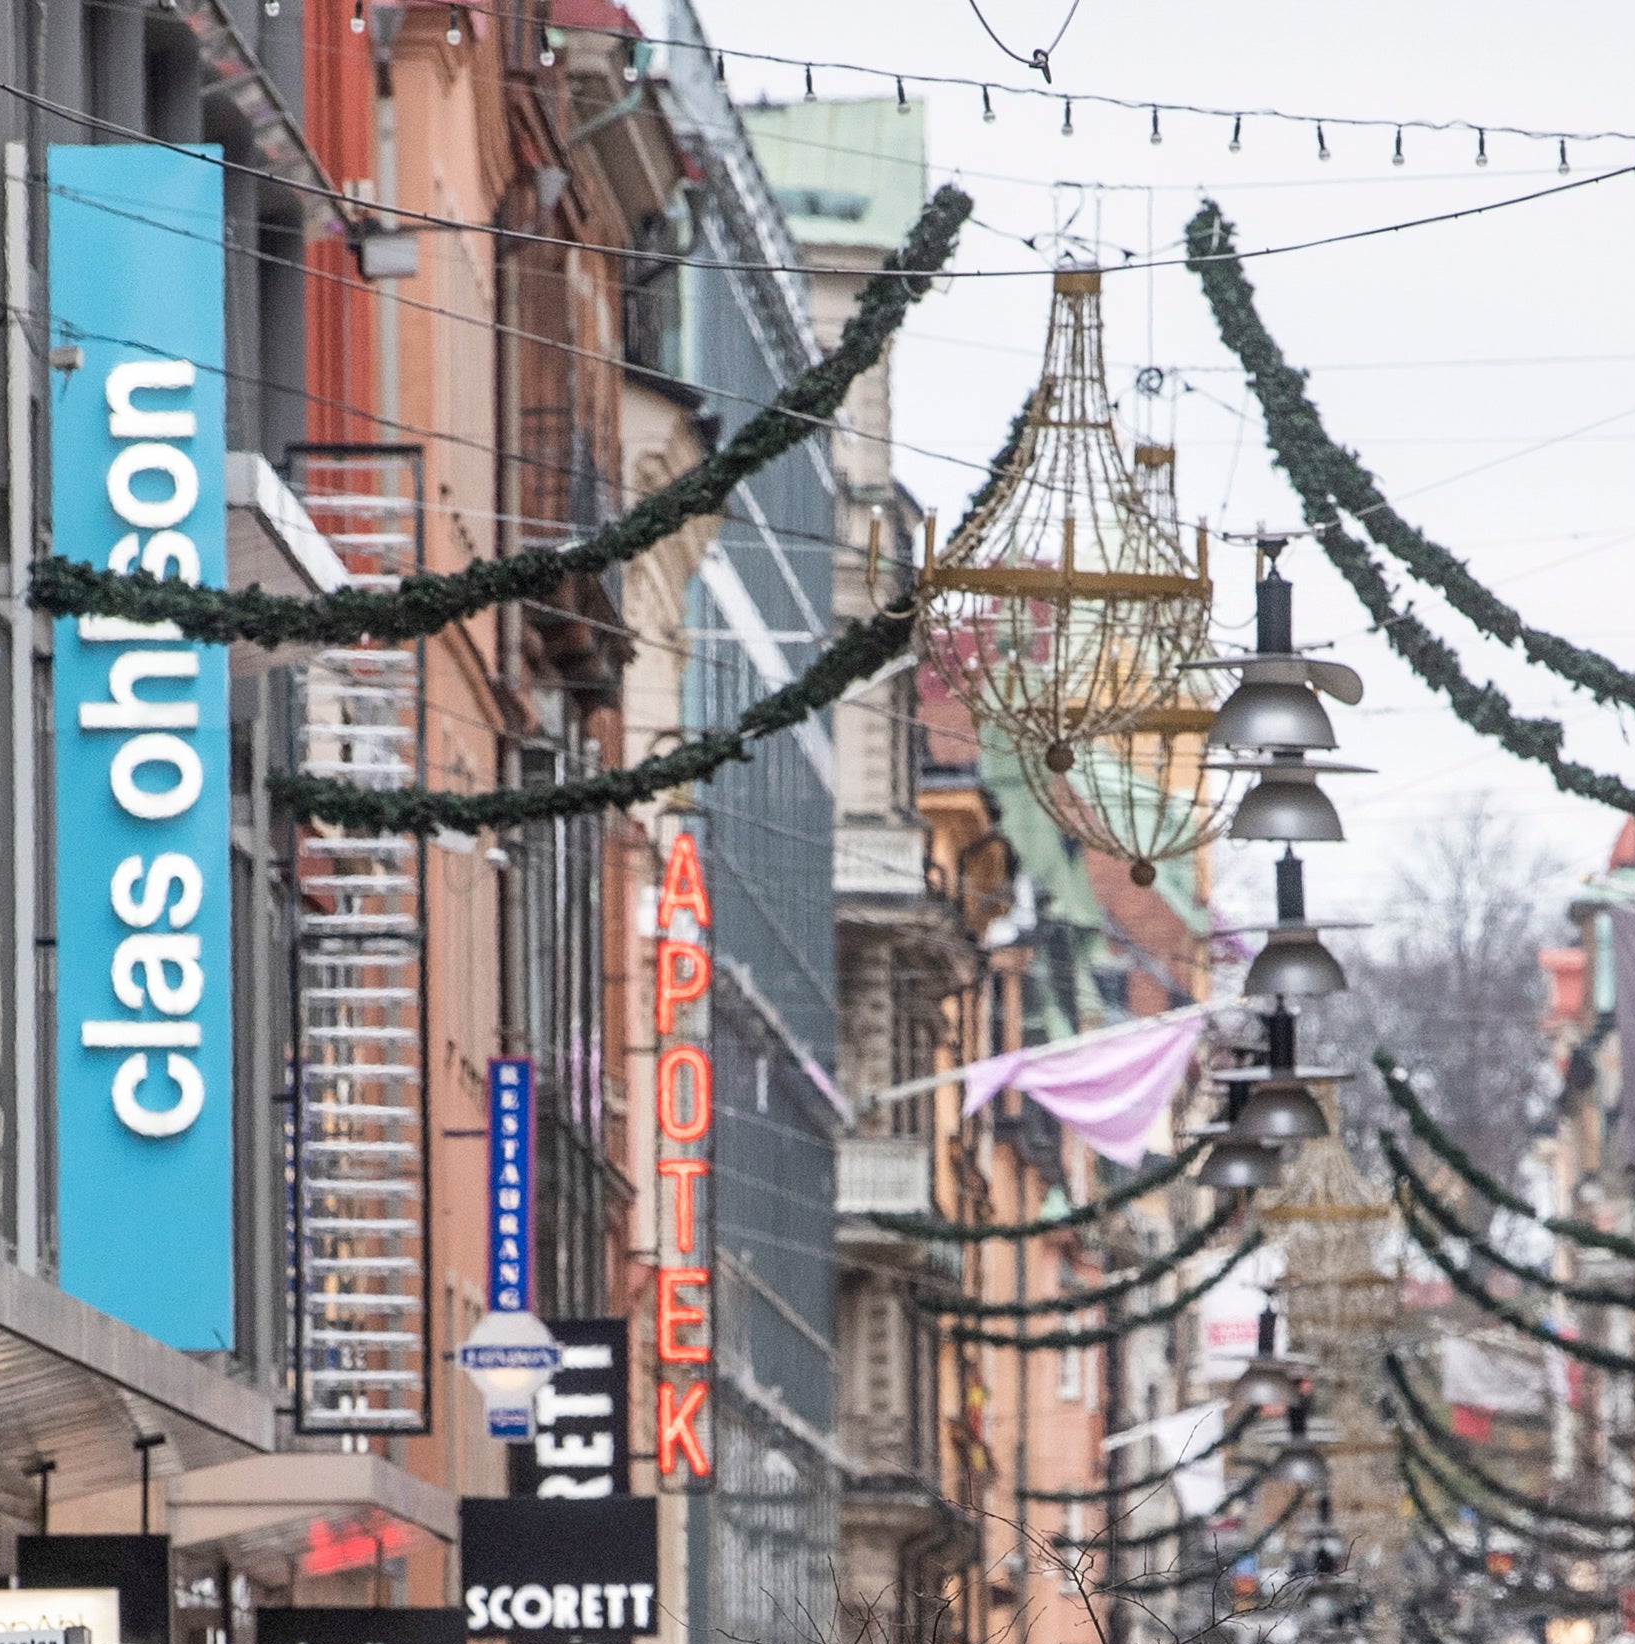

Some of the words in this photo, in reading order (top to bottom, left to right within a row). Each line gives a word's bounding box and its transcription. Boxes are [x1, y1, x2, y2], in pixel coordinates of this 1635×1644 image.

[77, 358, 203, 821] ohlson
[80, 852, 204, 1139] clas
[657, 833, 711, 1477] APOTEK
[465, 1583, 654, 1631] SCORETT
